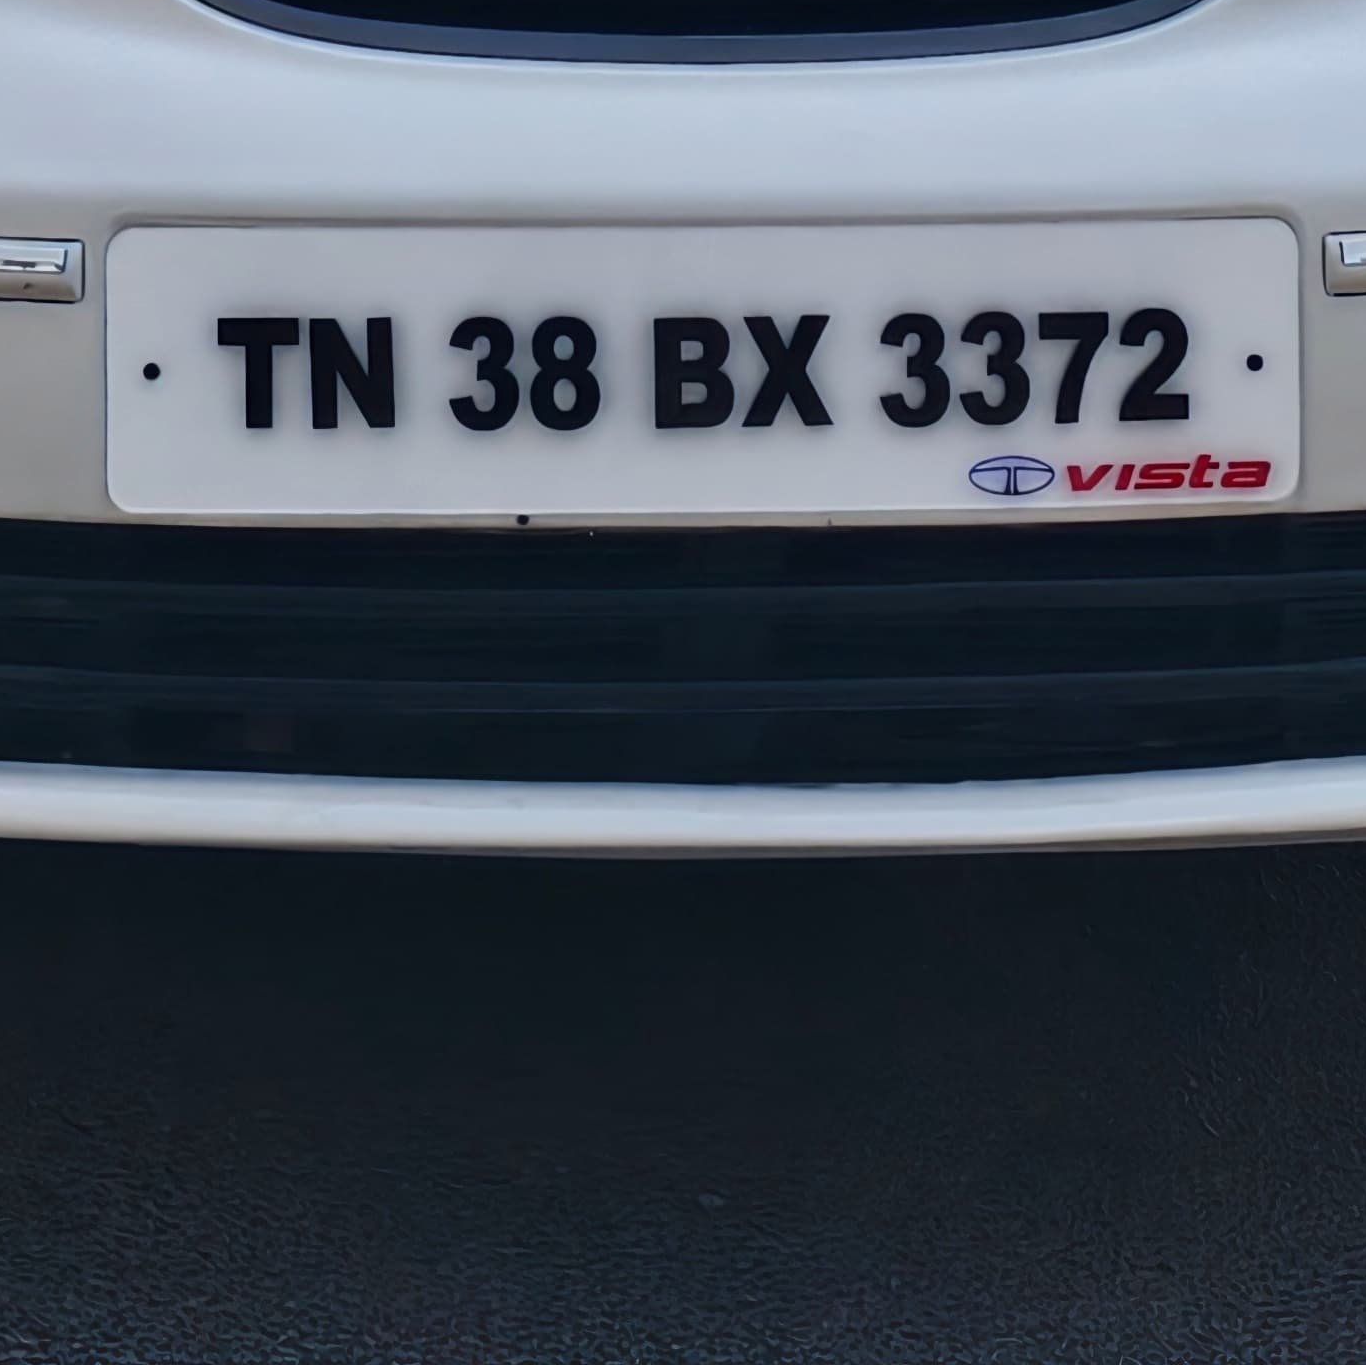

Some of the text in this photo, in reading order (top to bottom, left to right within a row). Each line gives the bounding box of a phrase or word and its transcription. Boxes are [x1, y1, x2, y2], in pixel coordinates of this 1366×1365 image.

[218, 308, 1189, 431] TN 38 BX 3372
[1067, 454, 1271, 492] vista
